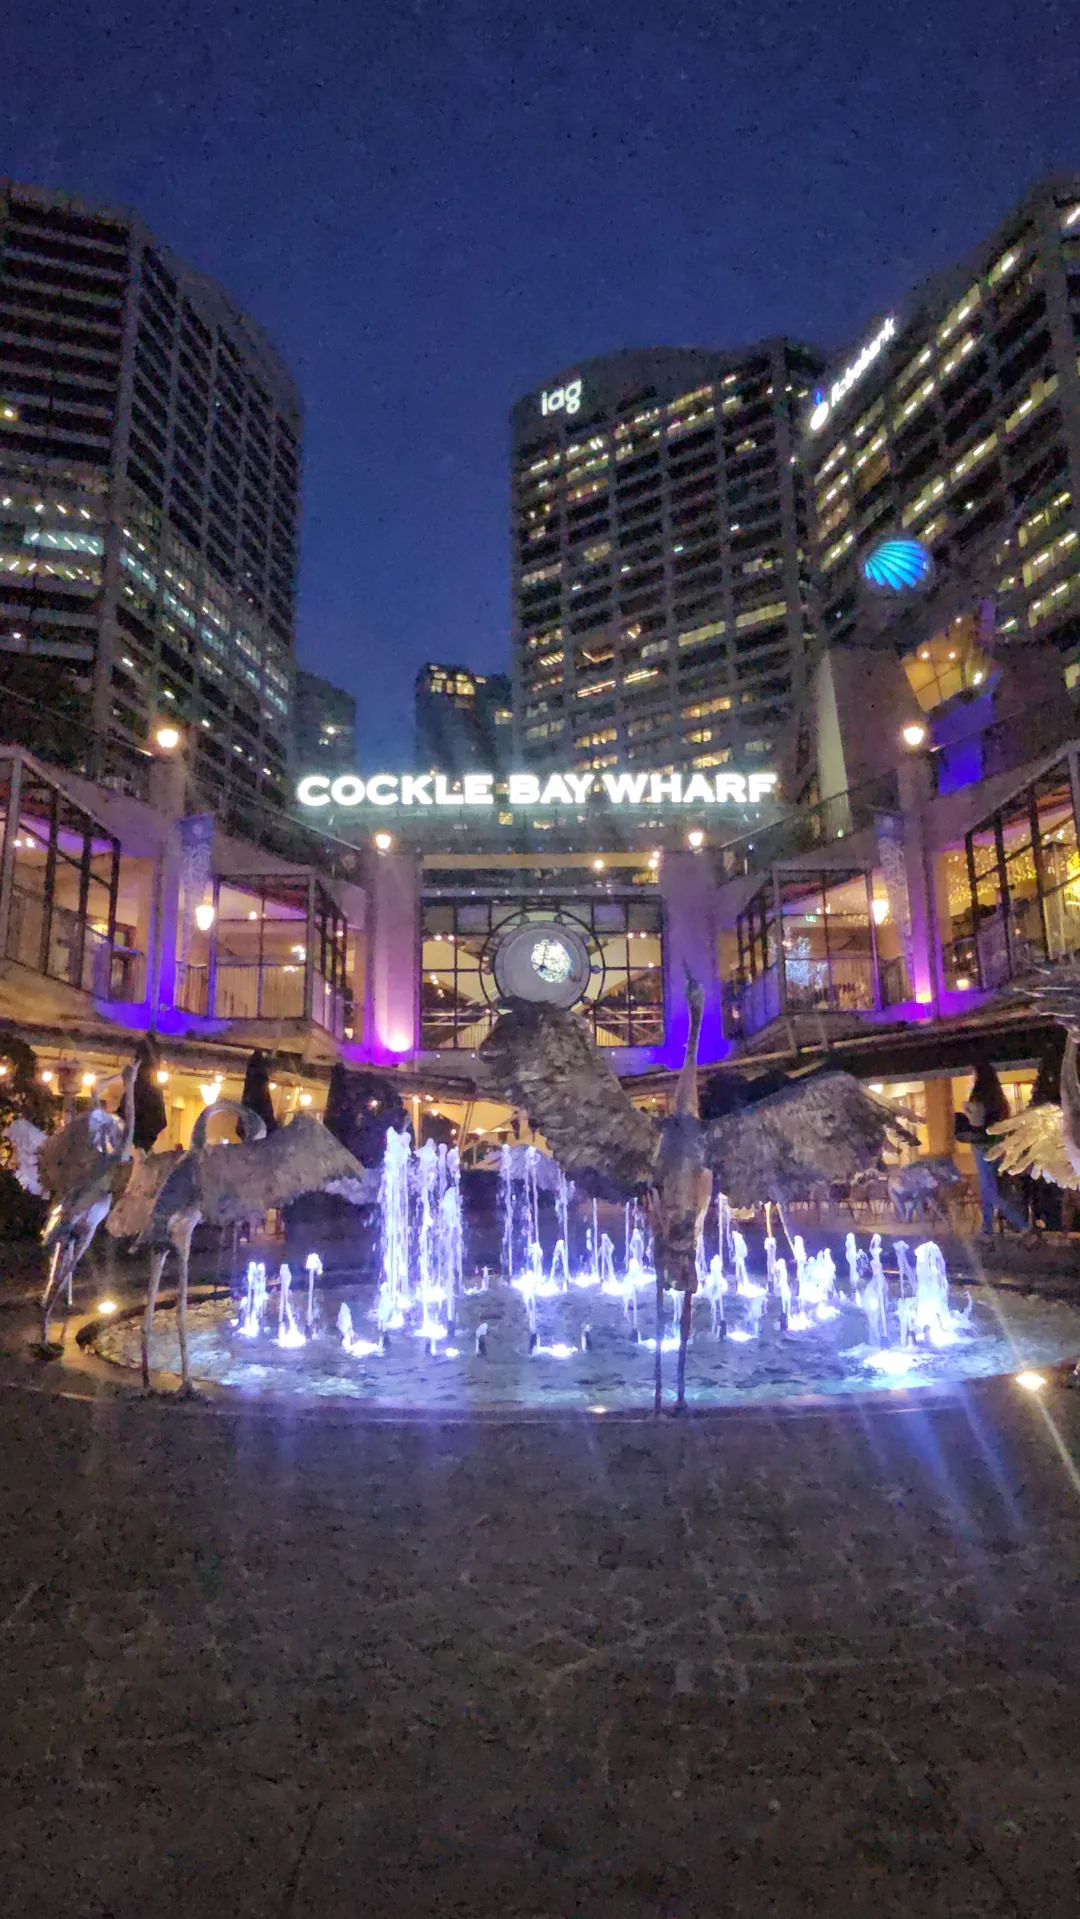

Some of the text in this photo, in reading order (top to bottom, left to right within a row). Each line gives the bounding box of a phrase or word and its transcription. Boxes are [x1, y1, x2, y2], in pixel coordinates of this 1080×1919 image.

[541, 379, 582, 416] iag
[297, 773, 778, 806] COCKLE BAY WHARF
